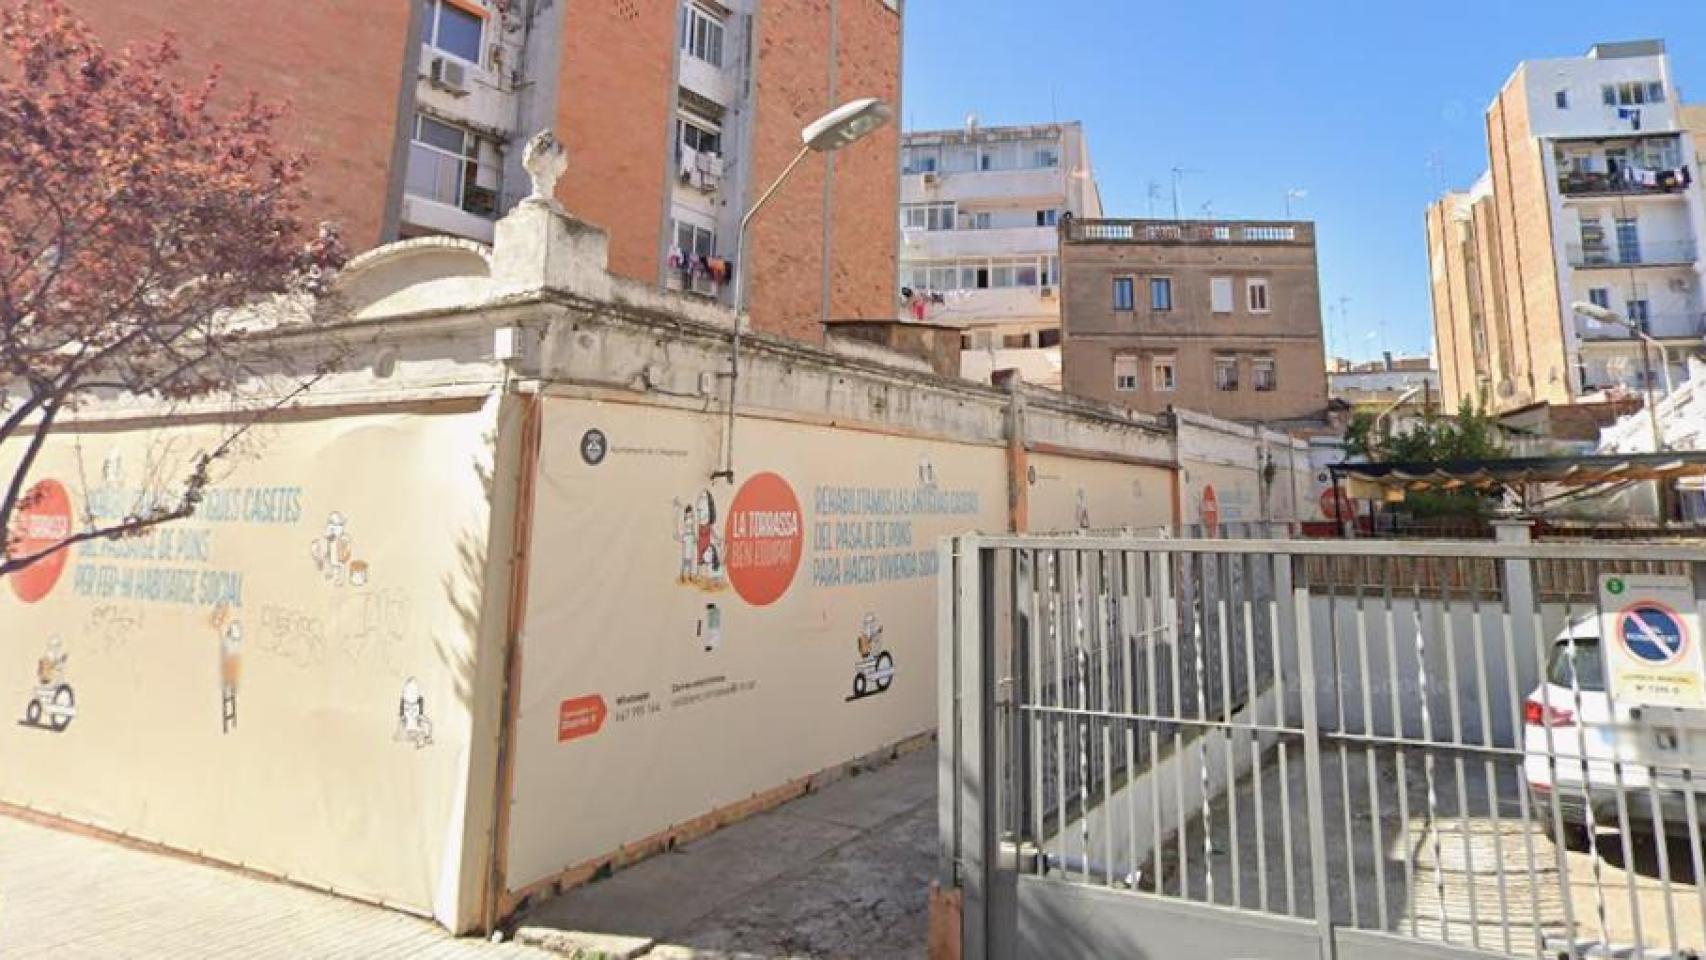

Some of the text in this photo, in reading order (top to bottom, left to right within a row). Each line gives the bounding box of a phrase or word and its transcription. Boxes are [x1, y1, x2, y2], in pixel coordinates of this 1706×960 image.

[733, 510, 798, 538] LA TORRASSA
[815, 522, 832, 550] DEL
[813, 557, 840, 587] PARA
